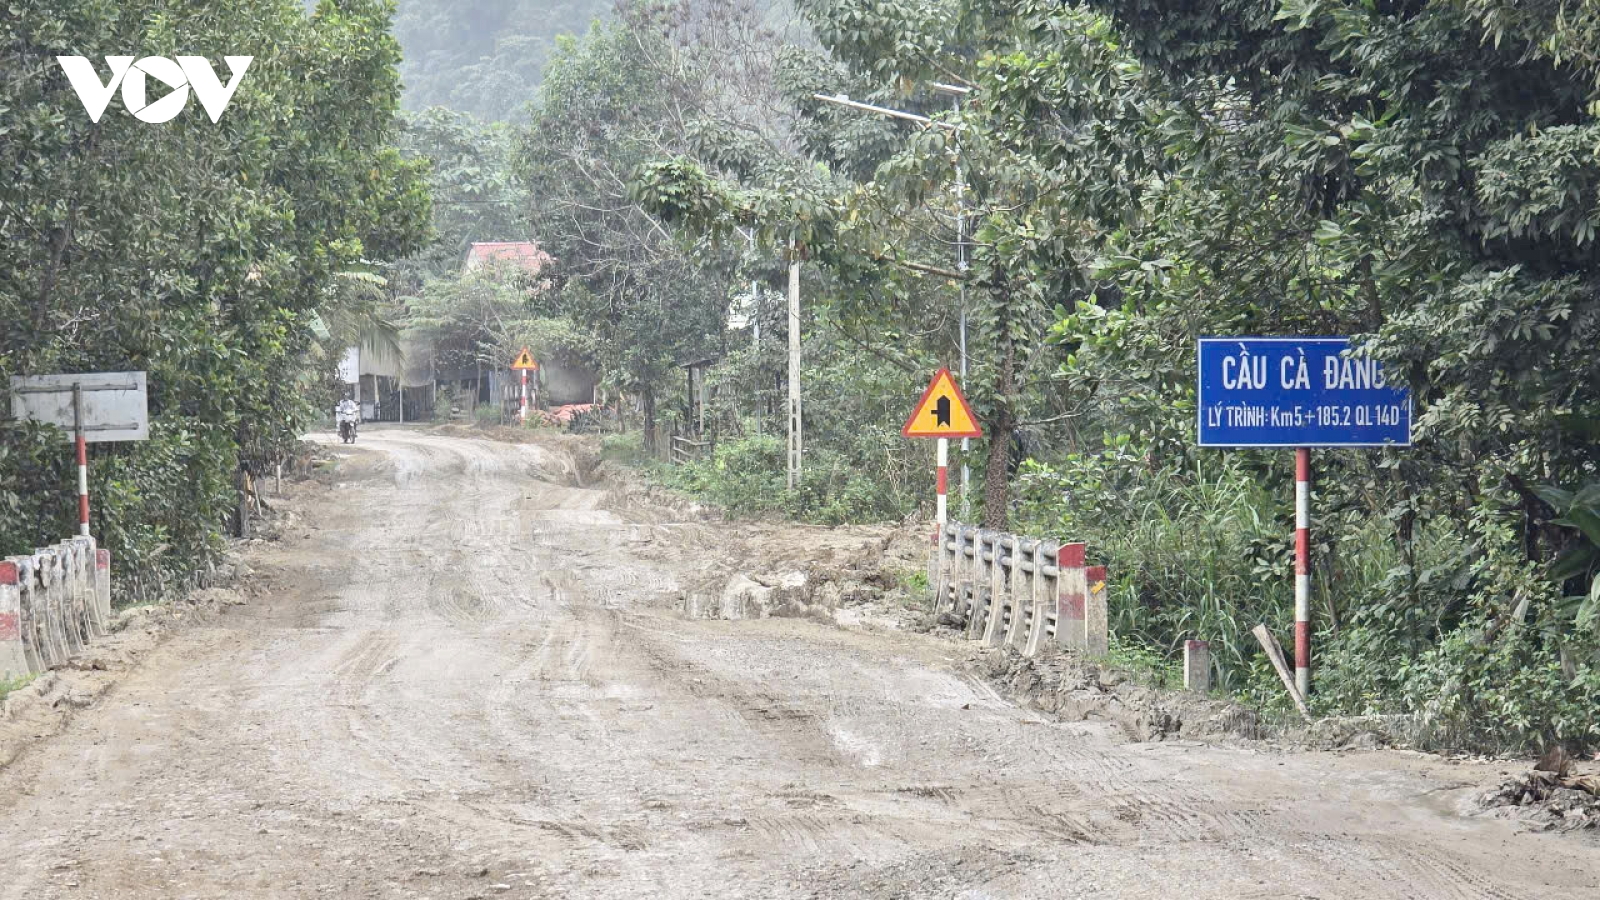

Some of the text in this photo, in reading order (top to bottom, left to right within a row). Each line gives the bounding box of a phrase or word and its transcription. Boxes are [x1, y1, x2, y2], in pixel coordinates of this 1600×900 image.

[1222, 342, 1267, 390] CẦU
[1280, 347, 1311, 390] CÀ
[1208, 401, 1223, 427] LÝ
[1226, 401, 1269, 427] TRÌNH:
